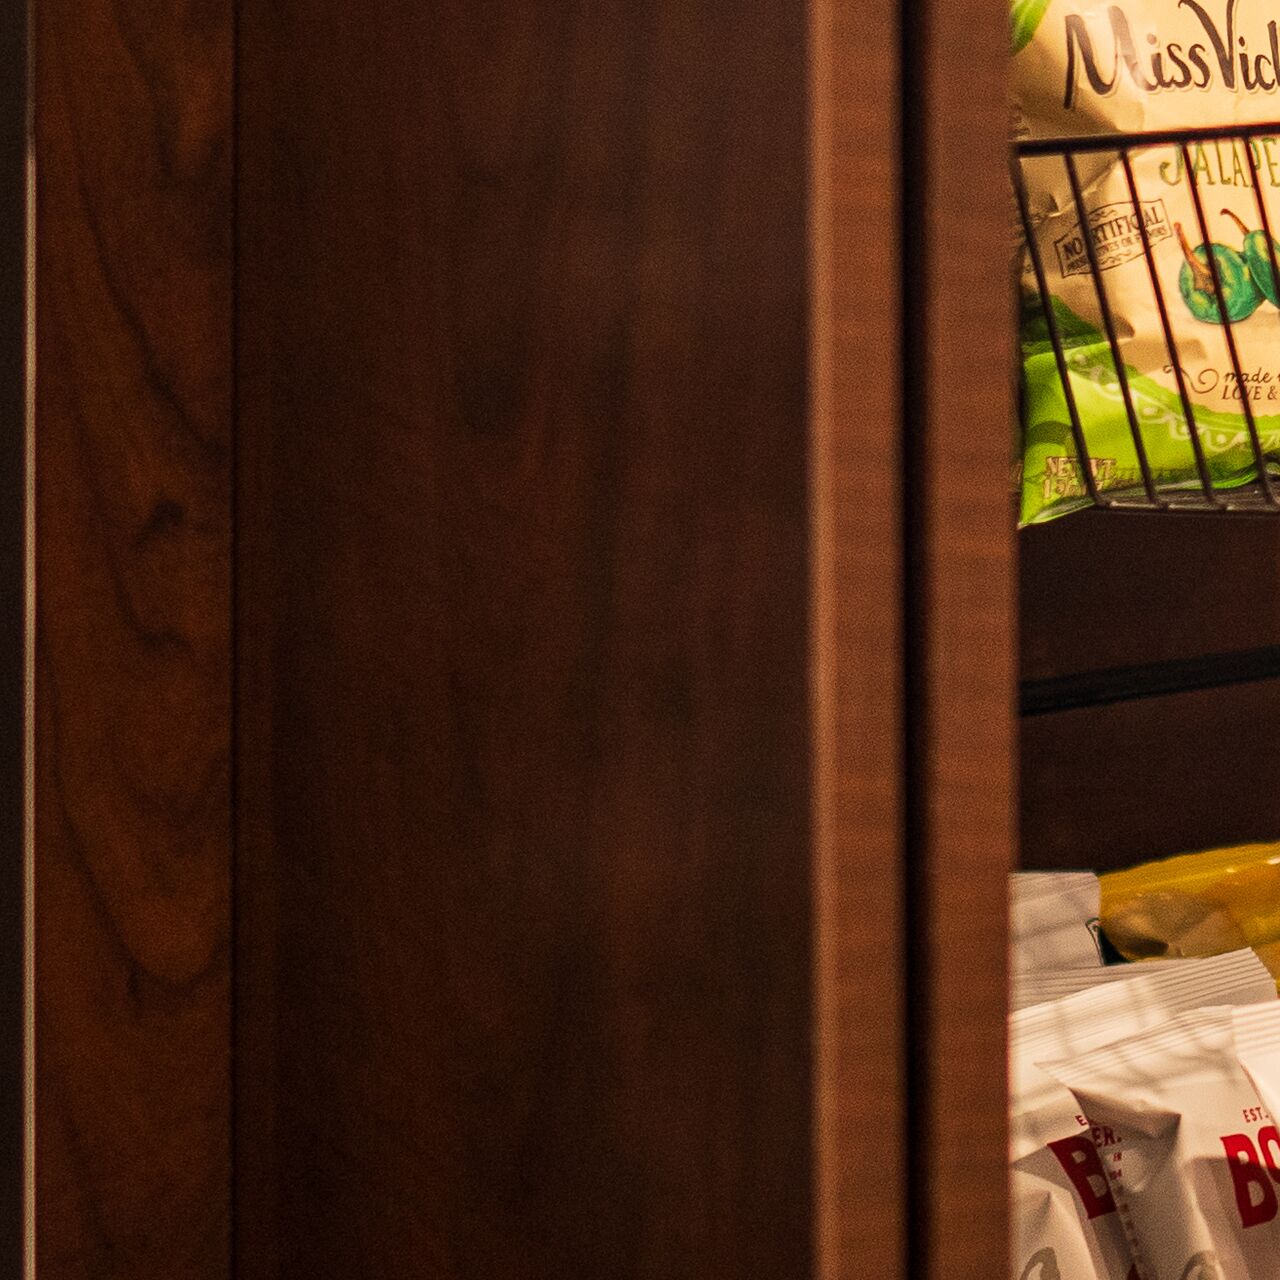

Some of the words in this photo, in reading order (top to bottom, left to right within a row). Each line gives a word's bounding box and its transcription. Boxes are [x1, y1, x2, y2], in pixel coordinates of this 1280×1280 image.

[1064, 5, 1211, 110] Miss
[1224, 368, 1272, 384] made
[1267, 387, 1277, 401] &
